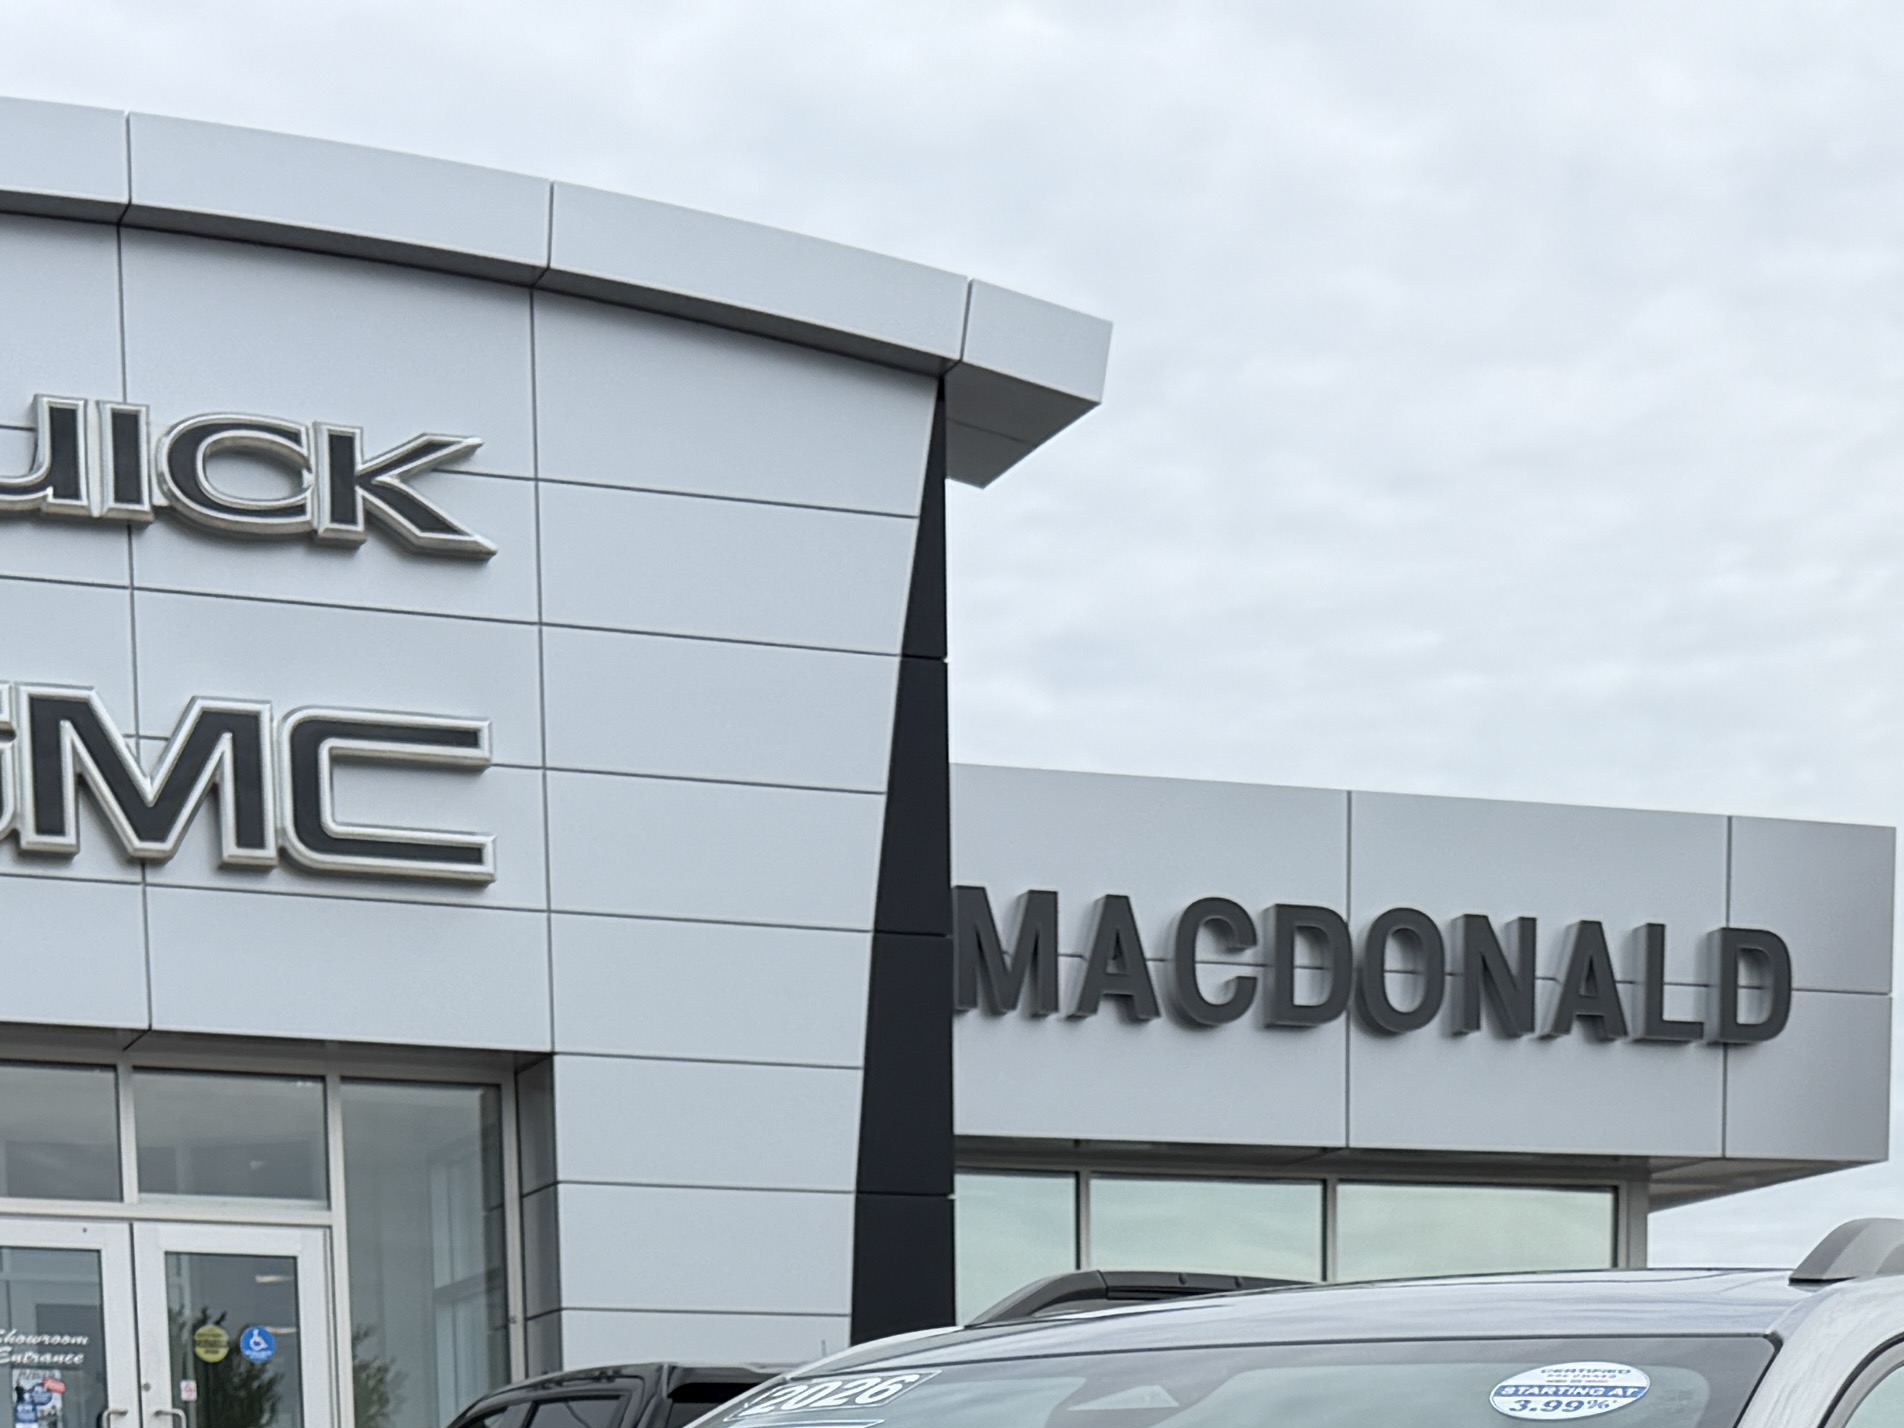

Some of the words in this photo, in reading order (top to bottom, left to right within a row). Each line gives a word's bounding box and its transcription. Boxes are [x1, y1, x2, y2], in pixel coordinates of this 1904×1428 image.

[953, 884, 1792, 1044] MACDONALD
[742, 1374, 922, 1415] 2026
[1501, 1386, 1605, 1396] STARTING
[1608, 1387, 1638, 1396] AT
